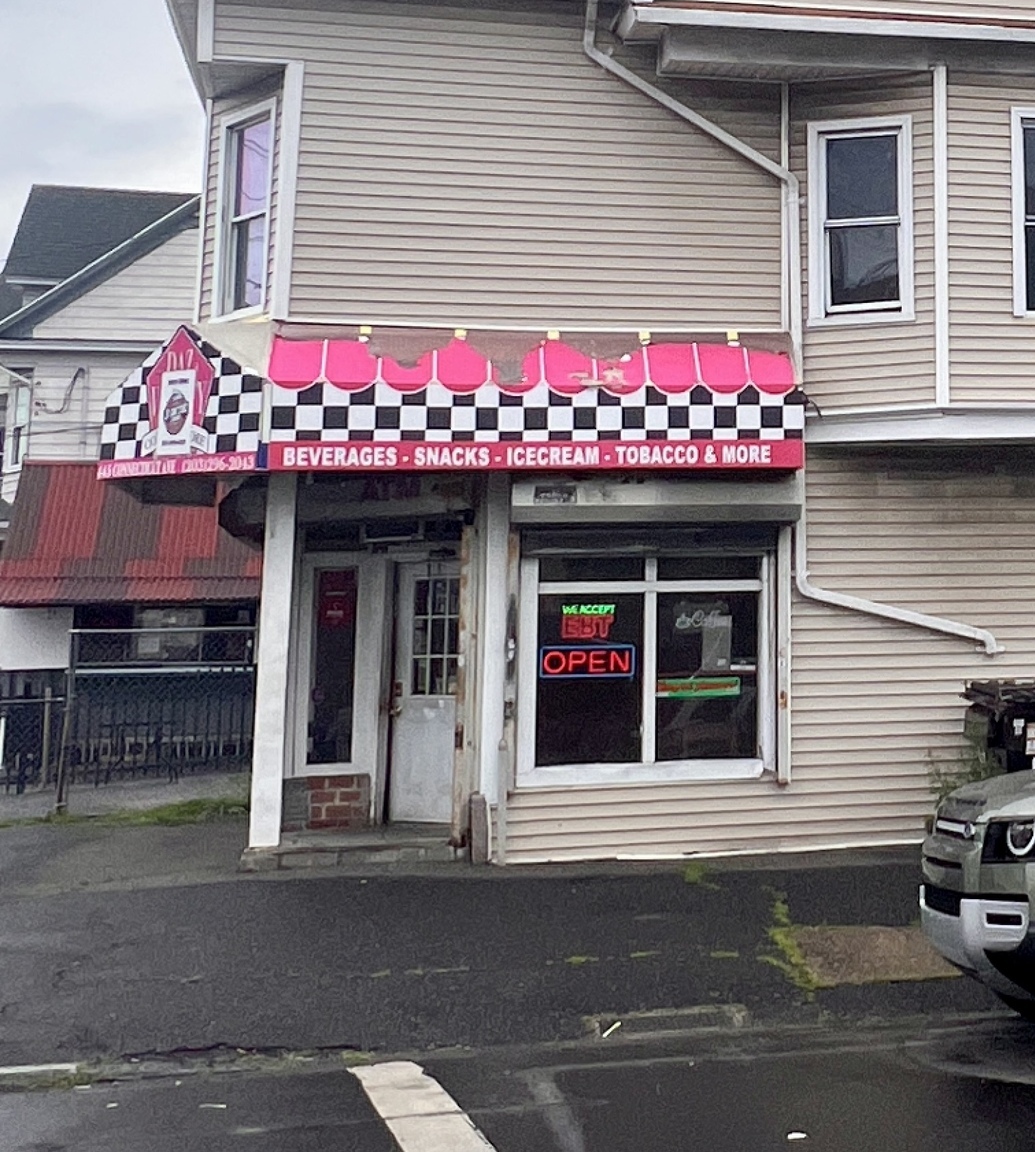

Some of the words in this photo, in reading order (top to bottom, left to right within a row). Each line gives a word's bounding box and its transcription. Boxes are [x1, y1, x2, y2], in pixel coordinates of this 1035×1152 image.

[283, 446, 397, 467] BEVERAGES
[413, 446, 490, 466] SNACKS
[506, 446, 600, 466] ICECREAM
[614, 445, 699, 465] TOBACCO
[704, 444, 717, 464] &
[721, 444, 771, 464] MORE
[562, 604, 579, 614] WE
[580, 604, 616, 615] ACCEPT
[561, 615, 615, 639] EBT
[543, 650, 631, 674] OPEN
